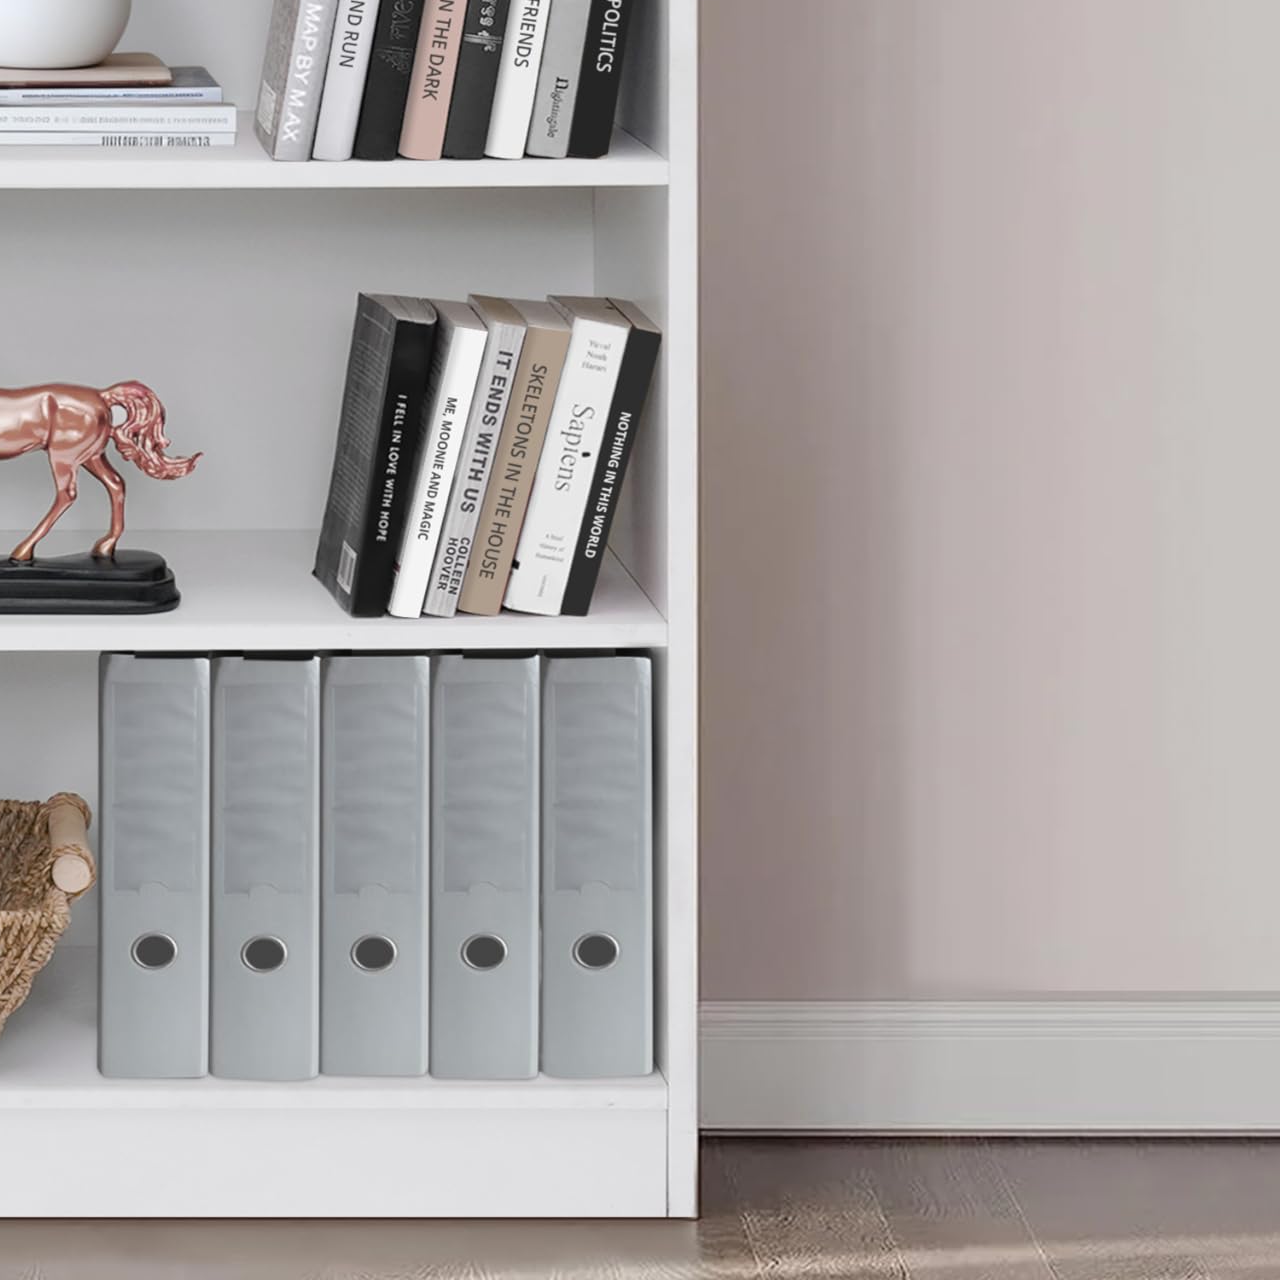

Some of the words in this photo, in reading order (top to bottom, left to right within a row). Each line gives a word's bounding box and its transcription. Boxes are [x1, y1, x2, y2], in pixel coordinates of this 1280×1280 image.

[301, 3, 324, 51] MAP
[431, 17, 452, 50] THE
[338, 30, 360, 68] RUN
[294, 55, 315, 85] BY
[422, 53, 445, 101] DARK
[496, 350, 514, 371] IT
[393, 402, 407, 426] FELL
[442, 396, 458, 417] ME,
[481, 374, 508, 426] ENDS
[510, 363, 548, 459] SKELETONS
[391, 430, 402, 443] IN
[432, 420, 453, 470] MOONIE
[555, 403, 595, 491] Sapiens
[607, 411, 632, 469] NOTHING
[386, 446, 400, 475] LOVE
[467, 432, 494, 482] WITH
[504, 462, 523, 482] IN
[381, 478, 395, 508] WITH
[426, 471, 442, 499] AND
[603, 470, 617, 485] IN
[460, 487, 480, 513] US
[494, 487, 517, 519] THE
[596, 486, 613, 513] THIS
[376, 511, 390, 542] HOPE
[417, 500, 436, 541] MAGIC
[584, 515, 606, 559] WORLD
[436, 537, 459, 591] HOOVER
[447, 537, 471, 595] COLLEEN
[478, 522, 507, 580] HOUSE
